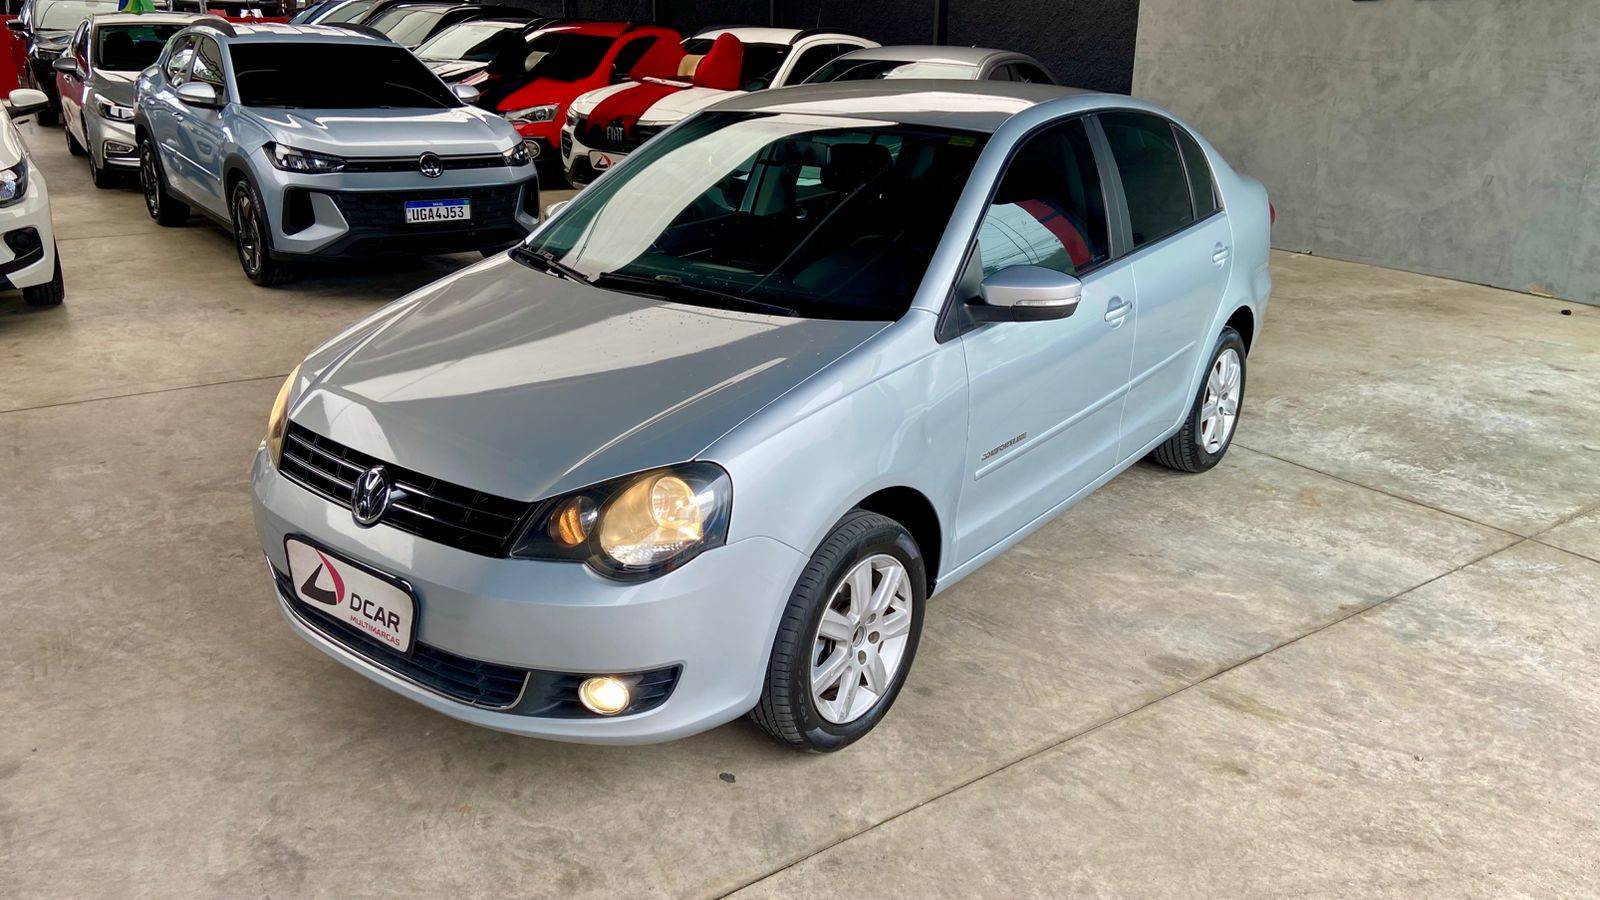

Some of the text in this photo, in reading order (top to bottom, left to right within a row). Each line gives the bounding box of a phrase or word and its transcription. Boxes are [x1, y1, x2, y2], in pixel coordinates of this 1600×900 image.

[606, 126, 624, 141] FIAT
[412, 206, 464, 221] UGA4J53
[349, 592, 400, 633] DCAR
[350, 615, 400, 646] MULTIMARCAS
